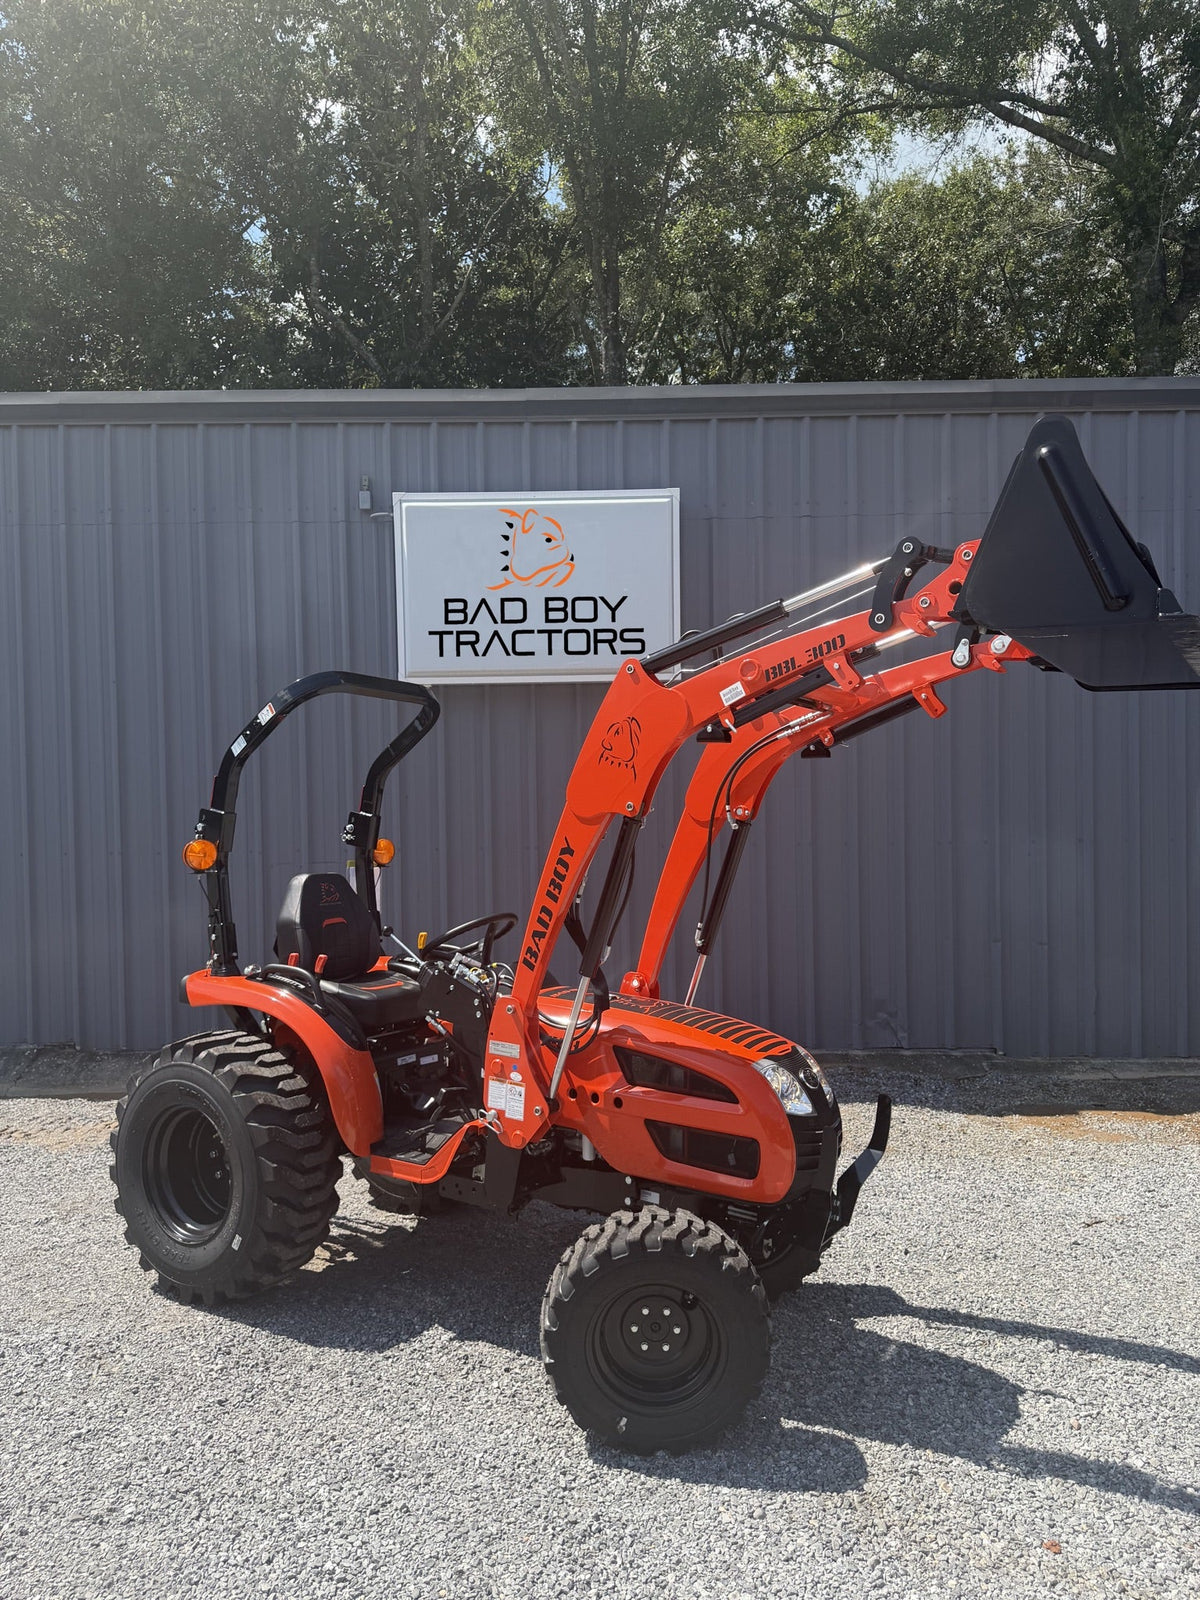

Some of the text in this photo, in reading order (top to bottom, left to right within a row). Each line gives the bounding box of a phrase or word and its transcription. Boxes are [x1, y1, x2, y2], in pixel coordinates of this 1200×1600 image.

[444, 595, 628, 625] BAD BOY
[428, 627, 646, 657] TRACTORS
[764, 634, 846, 682] BBL 300
[522, 836, 575, 972] BAD BOY
